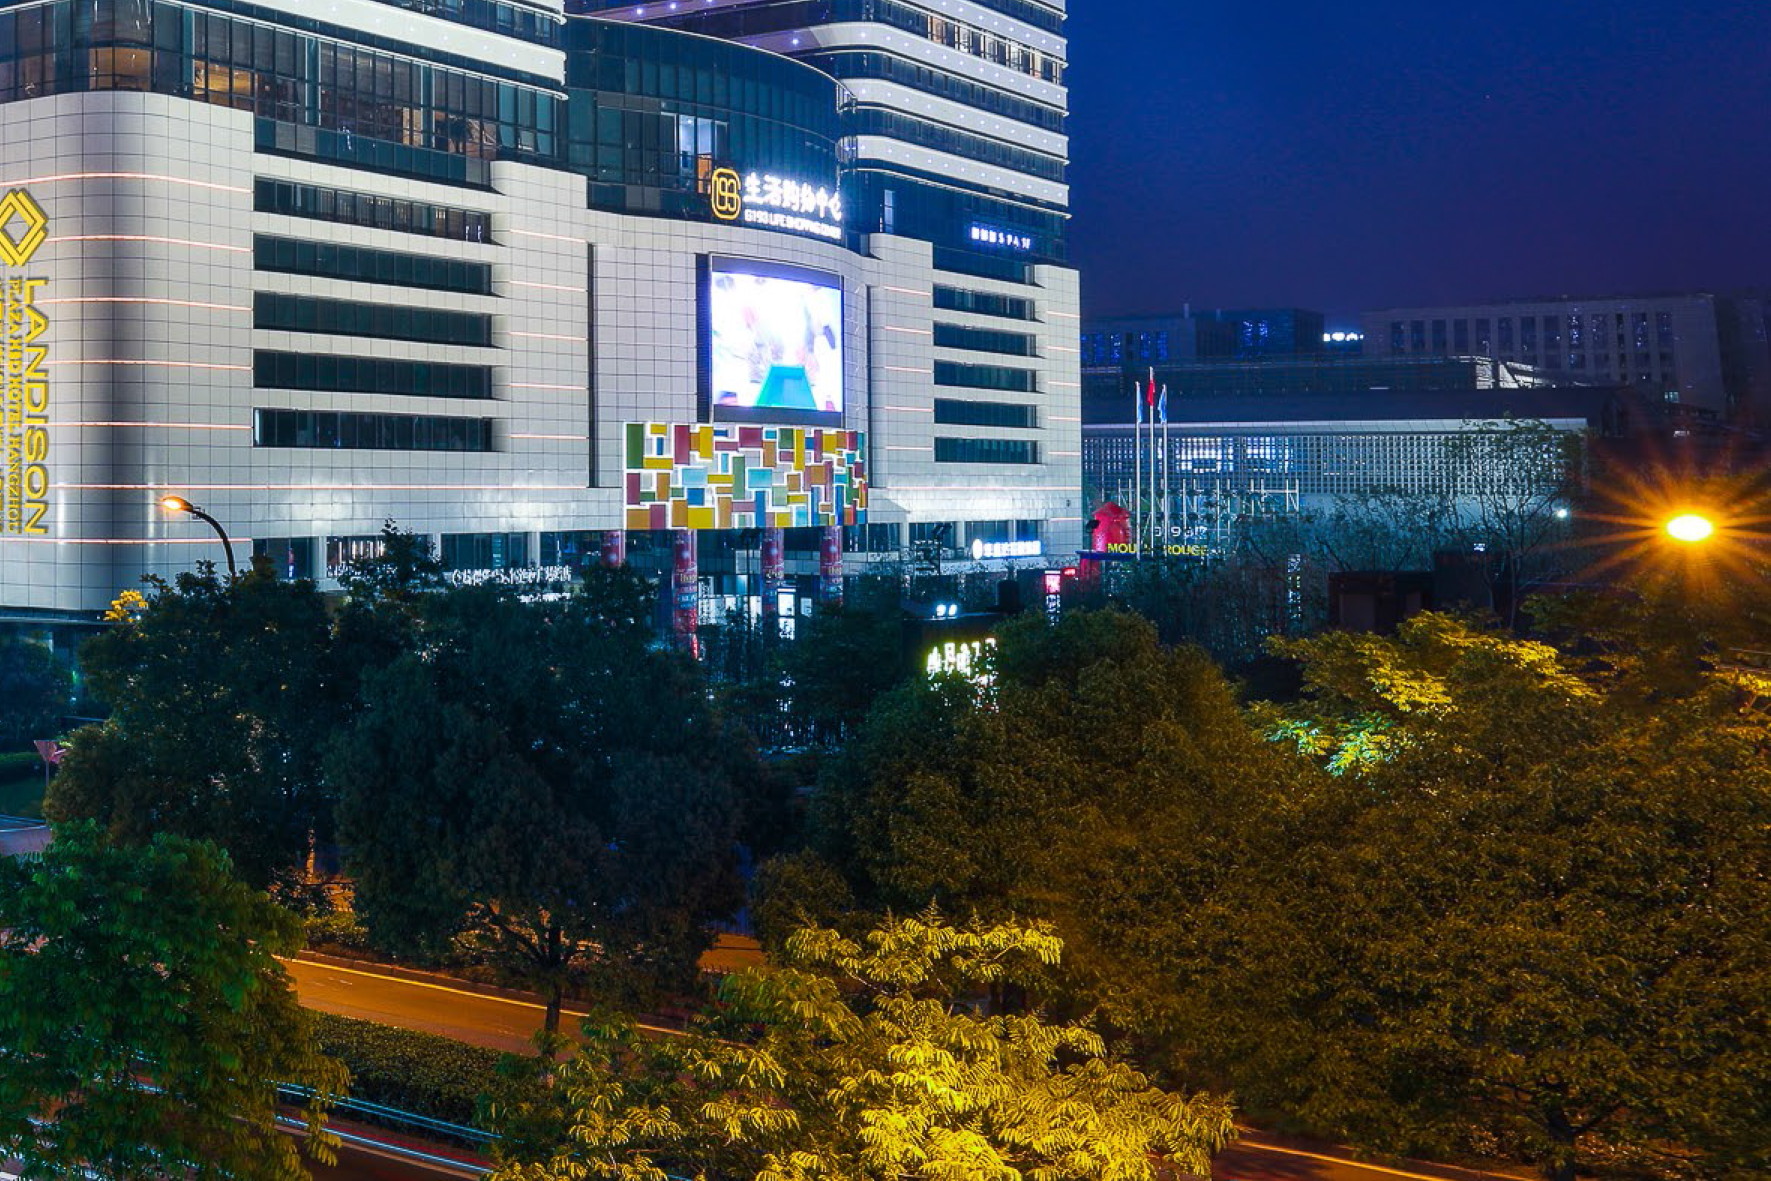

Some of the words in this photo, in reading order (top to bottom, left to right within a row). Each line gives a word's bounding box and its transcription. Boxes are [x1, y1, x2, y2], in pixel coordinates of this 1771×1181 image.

[743, 172, 841, 221] 生活购物中心
[8, 276, 22, 334] PLAZA
[8, 374, 22, 433] HOTEL
[24, 277, 49, 534] LANDISON
[8, 434, 22, 534] HANGZHOU
